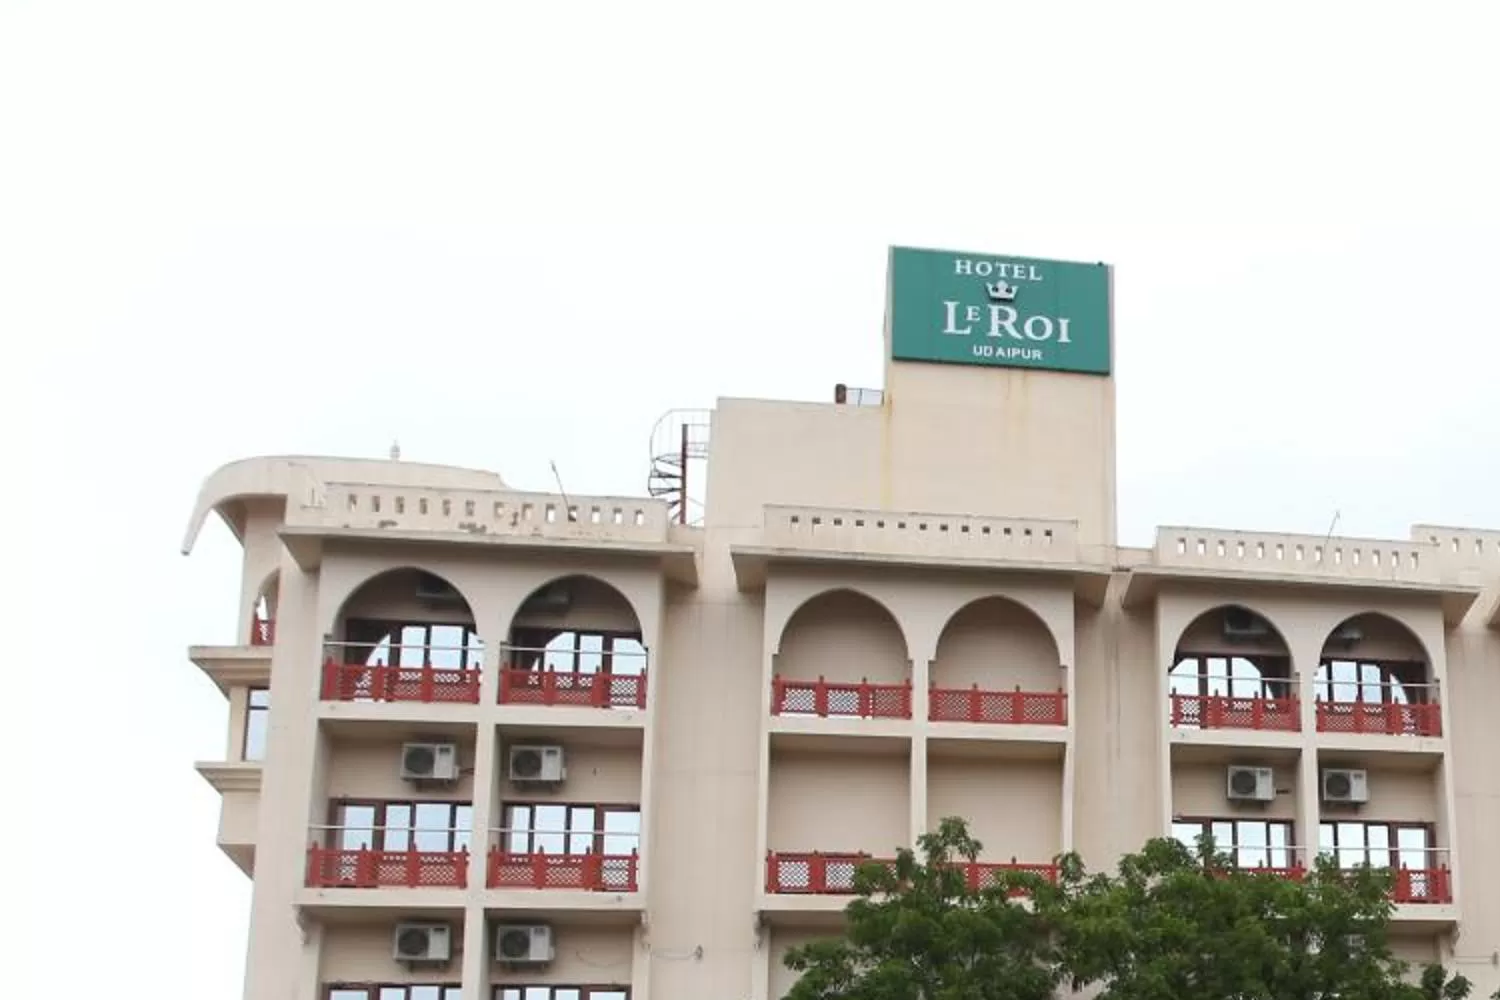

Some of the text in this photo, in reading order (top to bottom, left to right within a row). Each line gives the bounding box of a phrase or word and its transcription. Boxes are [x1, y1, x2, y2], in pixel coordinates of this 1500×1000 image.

[954, 259, 1043, 281] HOTEL
[987, 303, 1072, 343] ROI
[972, 344, 1043, 361] UDAIPUR
